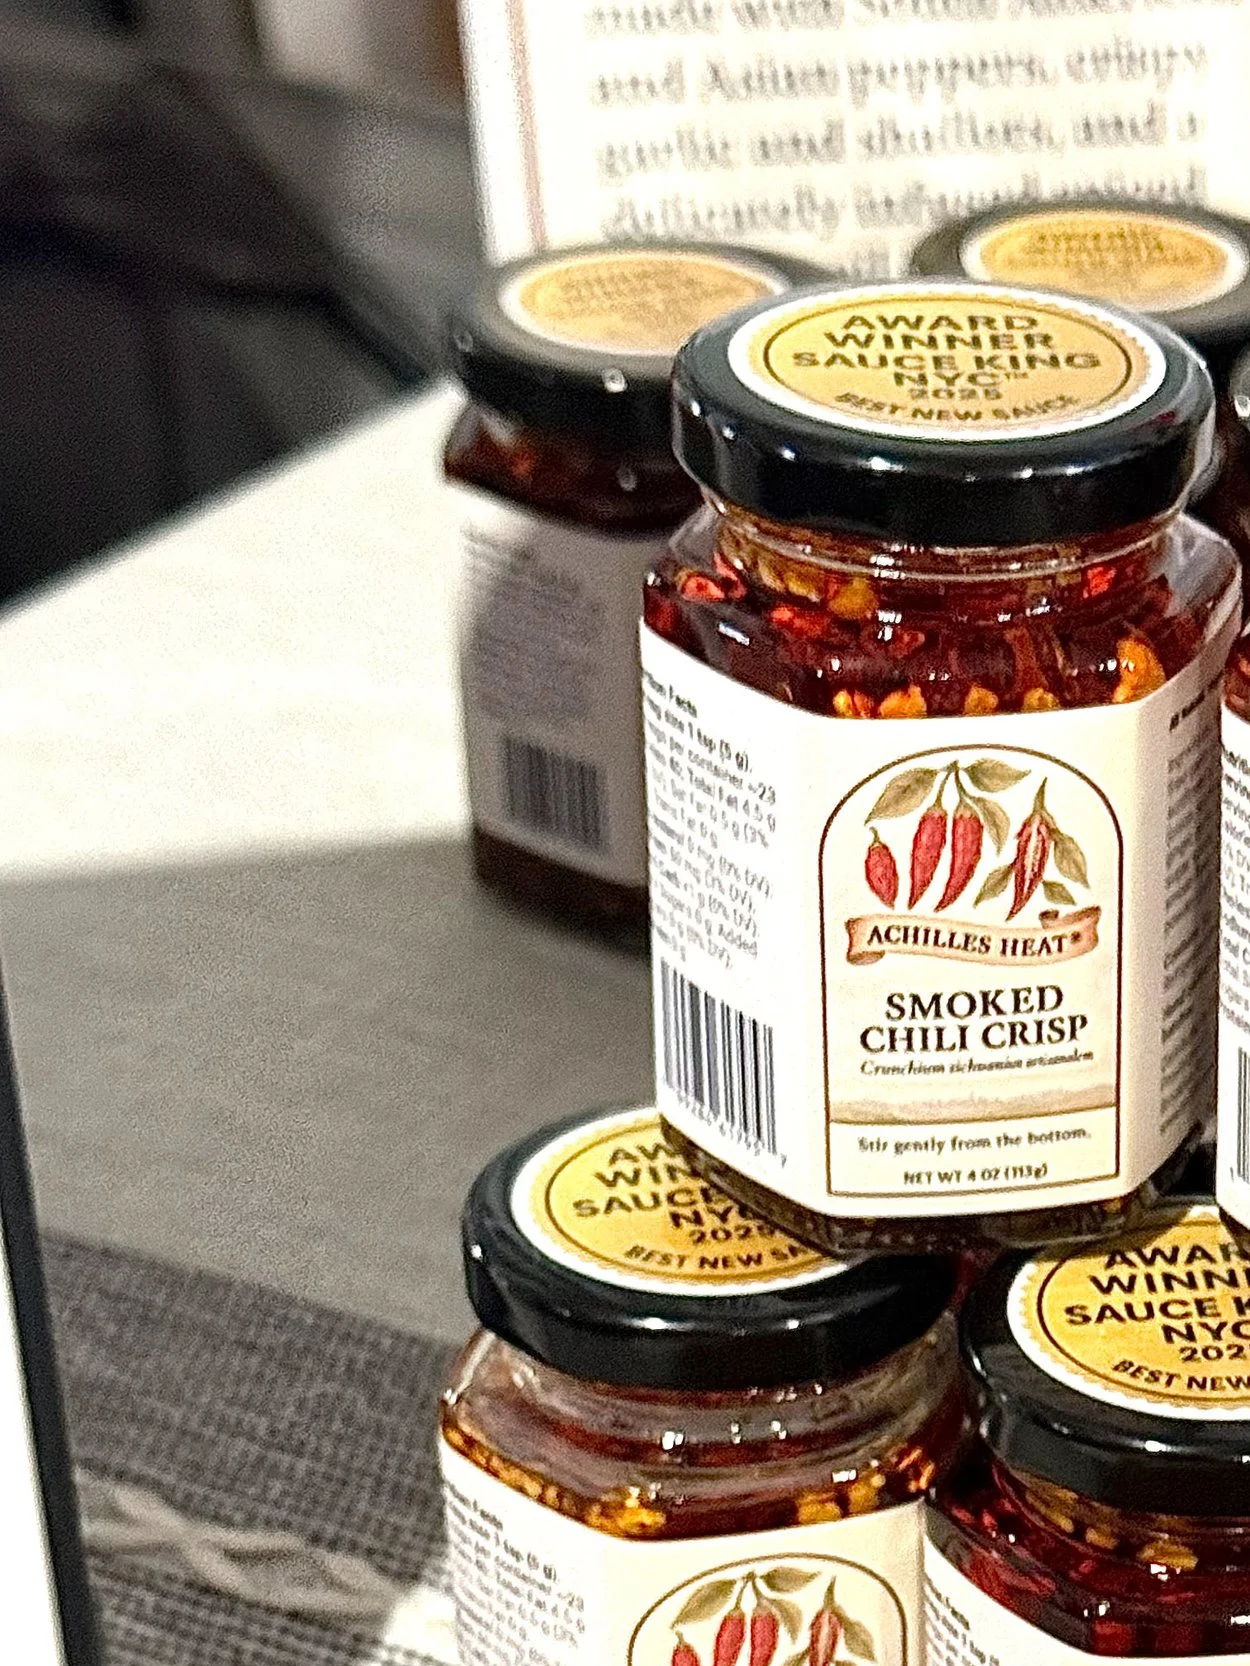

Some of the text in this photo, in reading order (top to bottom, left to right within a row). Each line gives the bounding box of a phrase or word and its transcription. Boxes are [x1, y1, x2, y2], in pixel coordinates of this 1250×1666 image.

[843, 314, 1039, 332] AWARD
[823, 332, 1056, 350] WINNER
[792, 351, 1102, 370] SAUCE KING
[908, 388, 1004, 401] 2025
[833, 393, 904, 418] BEST
[908, 408, 983, 422] NEW
[867, 925, 991, 953] ACHILLES
[884, 984, 1064, 1022] SMOKED
[860, 1013, 1089, 1054] CHILI CRISP
[858, 1136, 888, 1153] Stir
[894, 1134, 947, 1155] gently
[951, 1133, 992, 1150] from
[996, 1131, 1022, 1148] the
[903, 1169, 933, 1186] NET
[938, 1169, 963, 1185] WT
[967, 1169, 977, 1184] 4
[699, 1252, 763, 1270] NEW
[1104, 1243, 1250, 1270] AWAR
[1065, 1296, 1222, 1326] SAUCE
[1111, 1358, 1180, 1387] BEST
